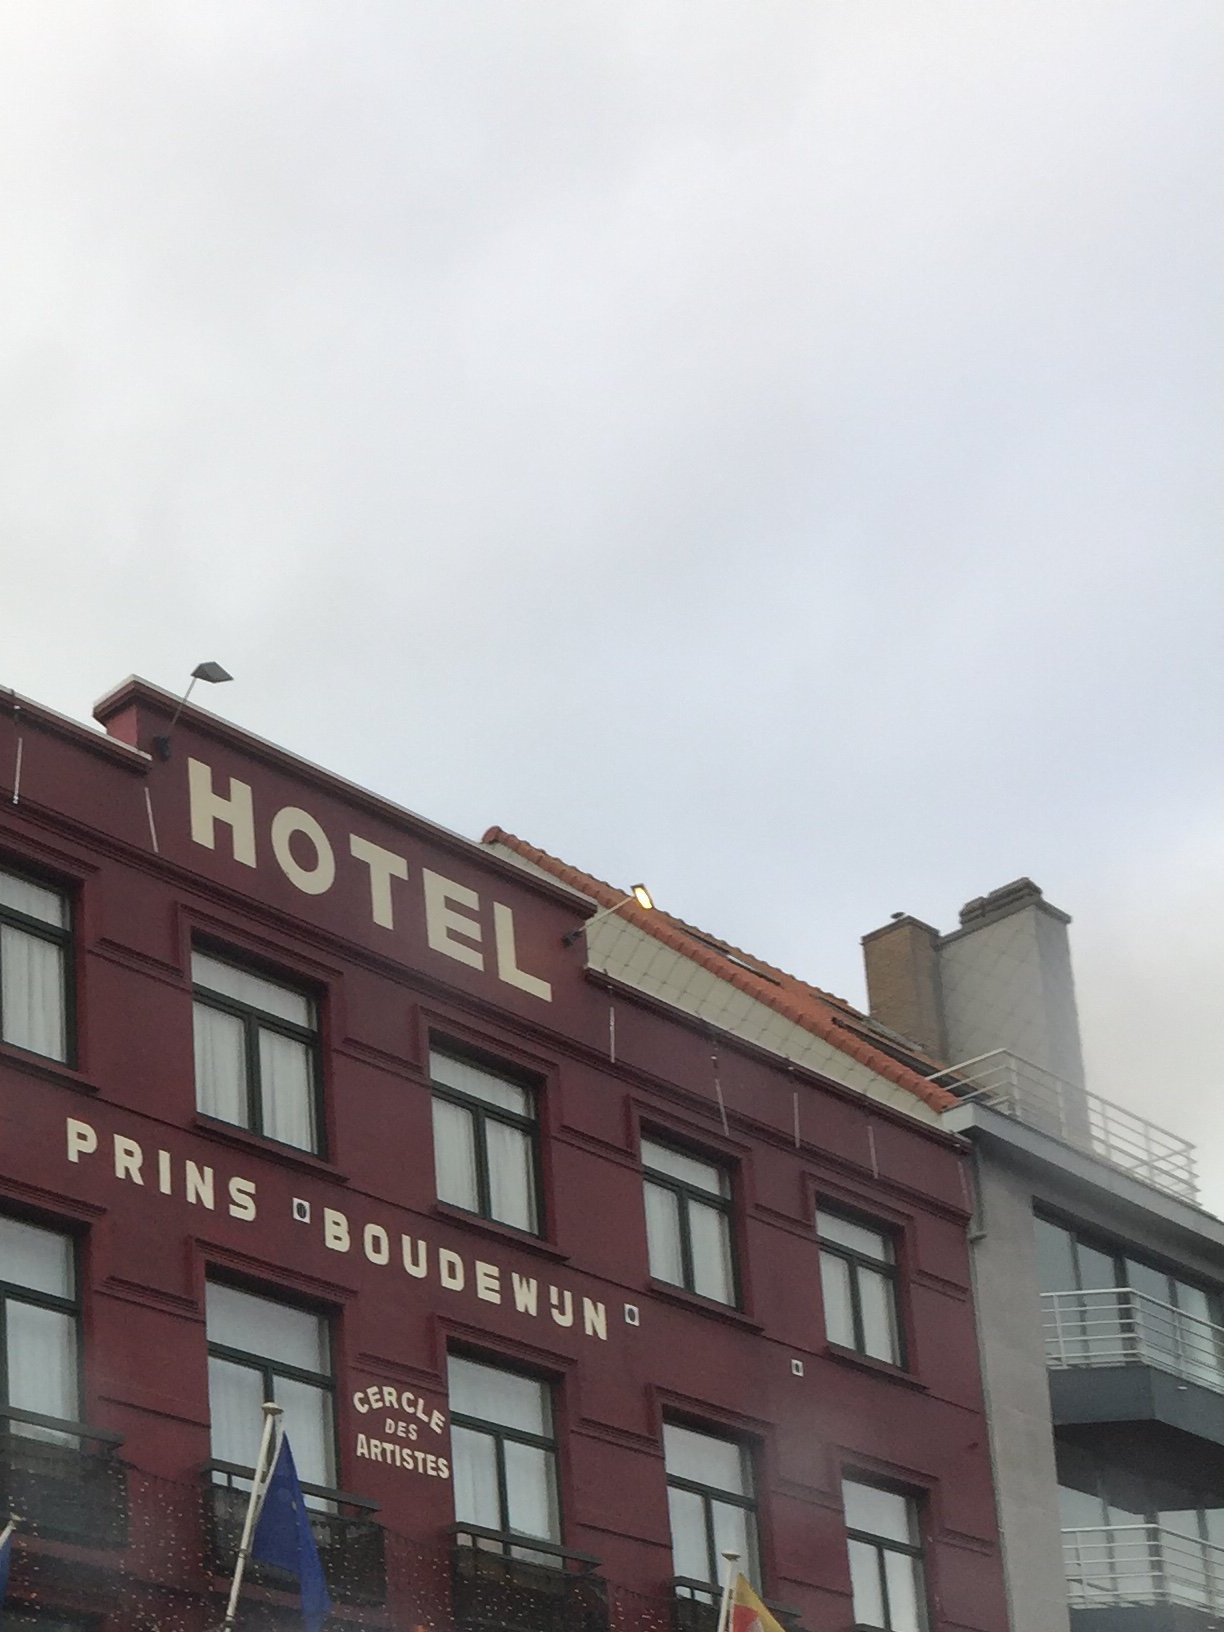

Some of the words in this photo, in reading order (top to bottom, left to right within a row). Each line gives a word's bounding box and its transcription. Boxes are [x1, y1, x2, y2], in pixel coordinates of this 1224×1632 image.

[187, 756, 553, 1003] HOTEL
[66, 1116, 258, 1222] PRINS
[323, 1207, 608, 1341] BOUDEWIJN
[352, 1385, 446, 1435] CERCLE
[384, 1417, 418, 1441] DES
[356, 1432, 450, 1479] ARTISTES
